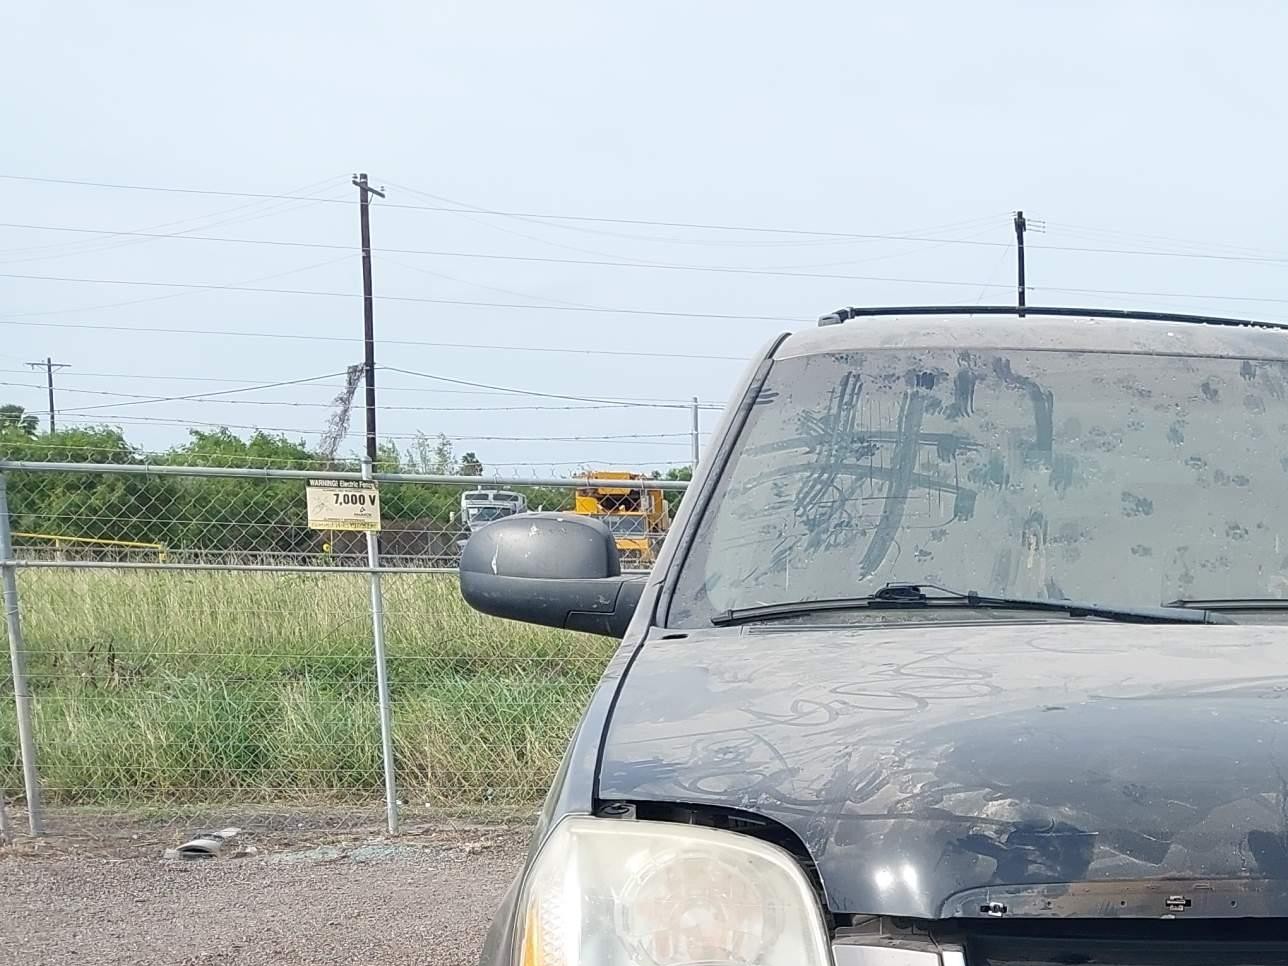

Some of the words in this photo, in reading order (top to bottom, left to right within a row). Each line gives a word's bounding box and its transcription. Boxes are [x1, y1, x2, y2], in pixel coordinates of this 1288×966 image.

[309, 479, 338, 488] WARNING!
[339, 480, 358, 489] Electric
[333, 493, 366, 506] 7,000
[368, 494, 376, 506] V
